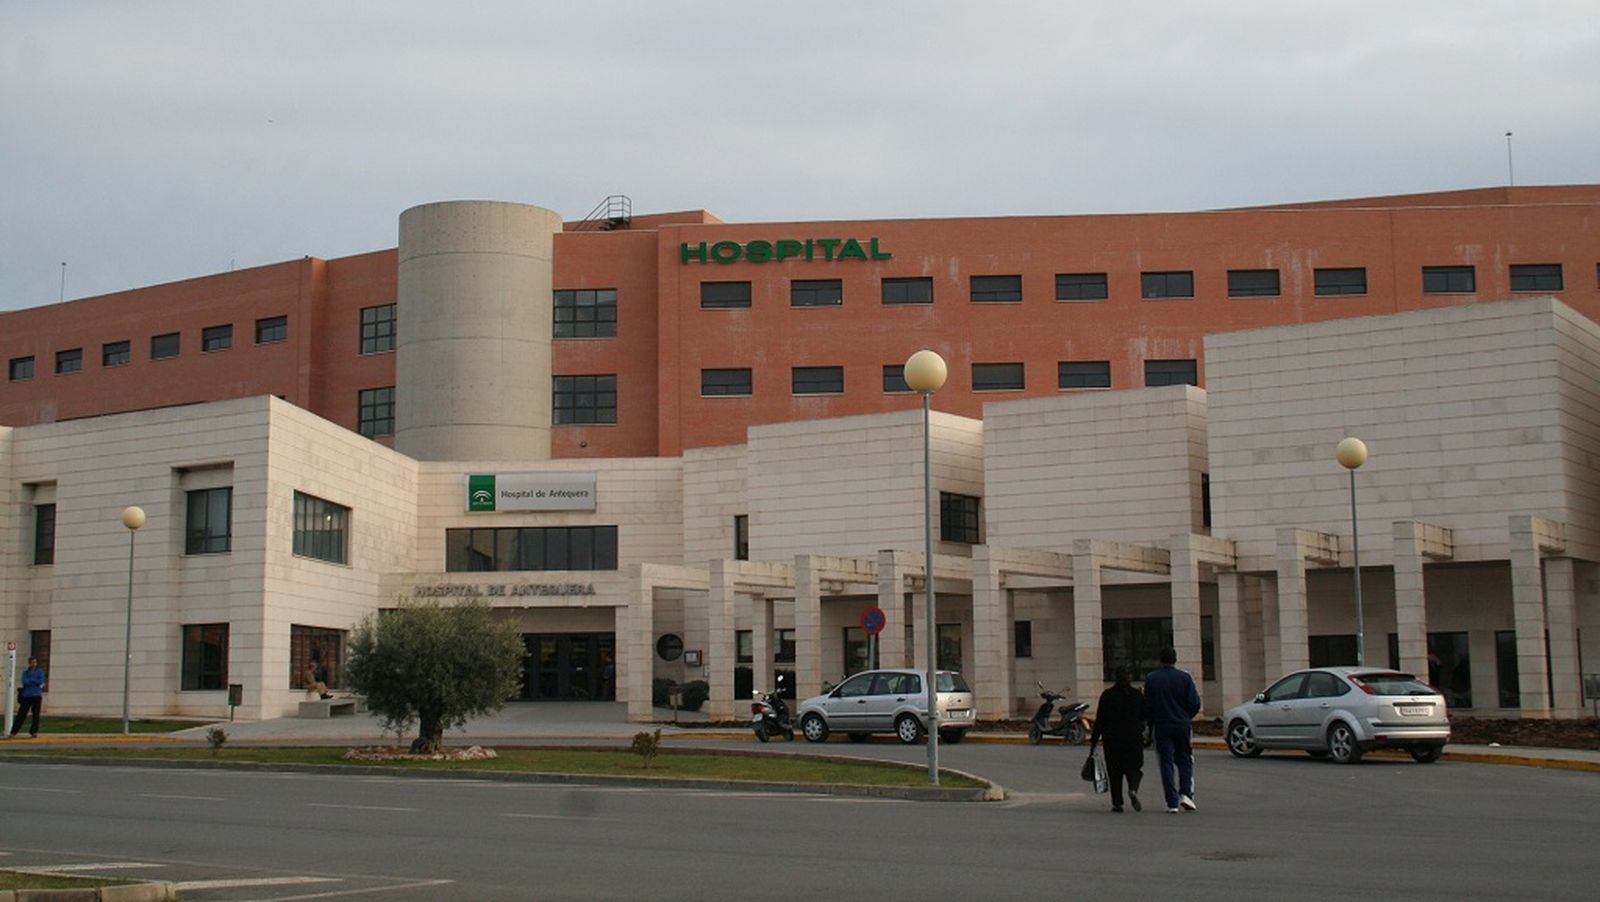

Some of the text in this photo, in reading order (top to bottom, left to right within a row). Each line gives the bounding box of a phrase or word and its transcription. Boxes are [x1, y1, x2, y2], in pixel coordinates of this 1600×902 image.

[680, 238, 892, 264] HOSPITAL
[501, 490, 588, 500] Hospital de Antequera
[414, 584, 596, 597] HOSPITAL DE ANTEQUERA
